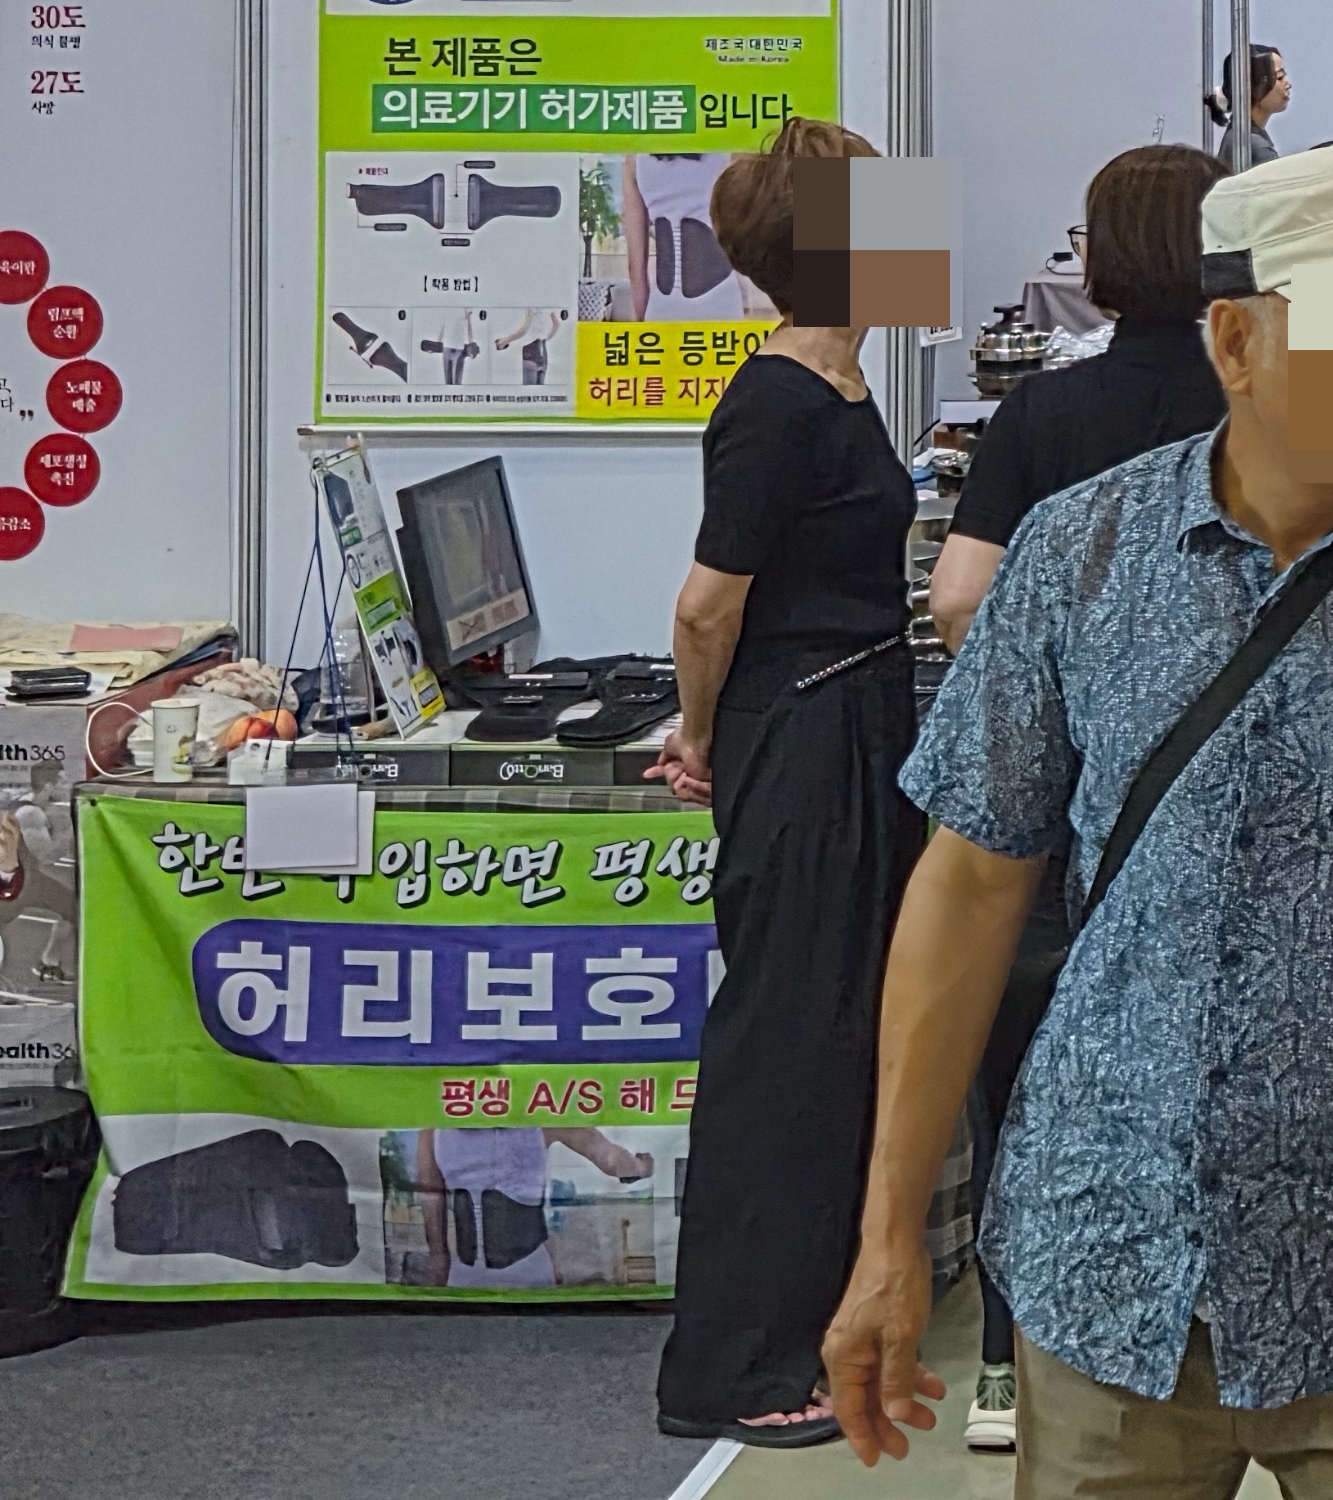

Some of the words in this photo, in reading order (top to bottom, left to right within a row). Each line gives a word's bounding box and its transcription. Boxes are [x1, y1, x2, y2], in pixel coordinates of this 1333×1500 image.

[31, 5, 86, 29] 30도
[383, 38, 422, 76] 본
[432, 37, 542, 77] 제품은
[749, 37, 802, 51] 대한민국
[30, 71, 85, 95] 27도
[381, 88, 527, 130] 의료기기
[540, 89, 688, 130] 허가제품
[700, 93, 793, 130] 입니다
[604, 331, 665, 367] 넓은
[588, 376, 667, 407] 허리를
[215, 940, 723, 1045] 허리보호
[440, 1077, 511, 1118] 평생
[527, 1079, 604, 1117] A/S
[619, 1078, 658, 1116] 해
